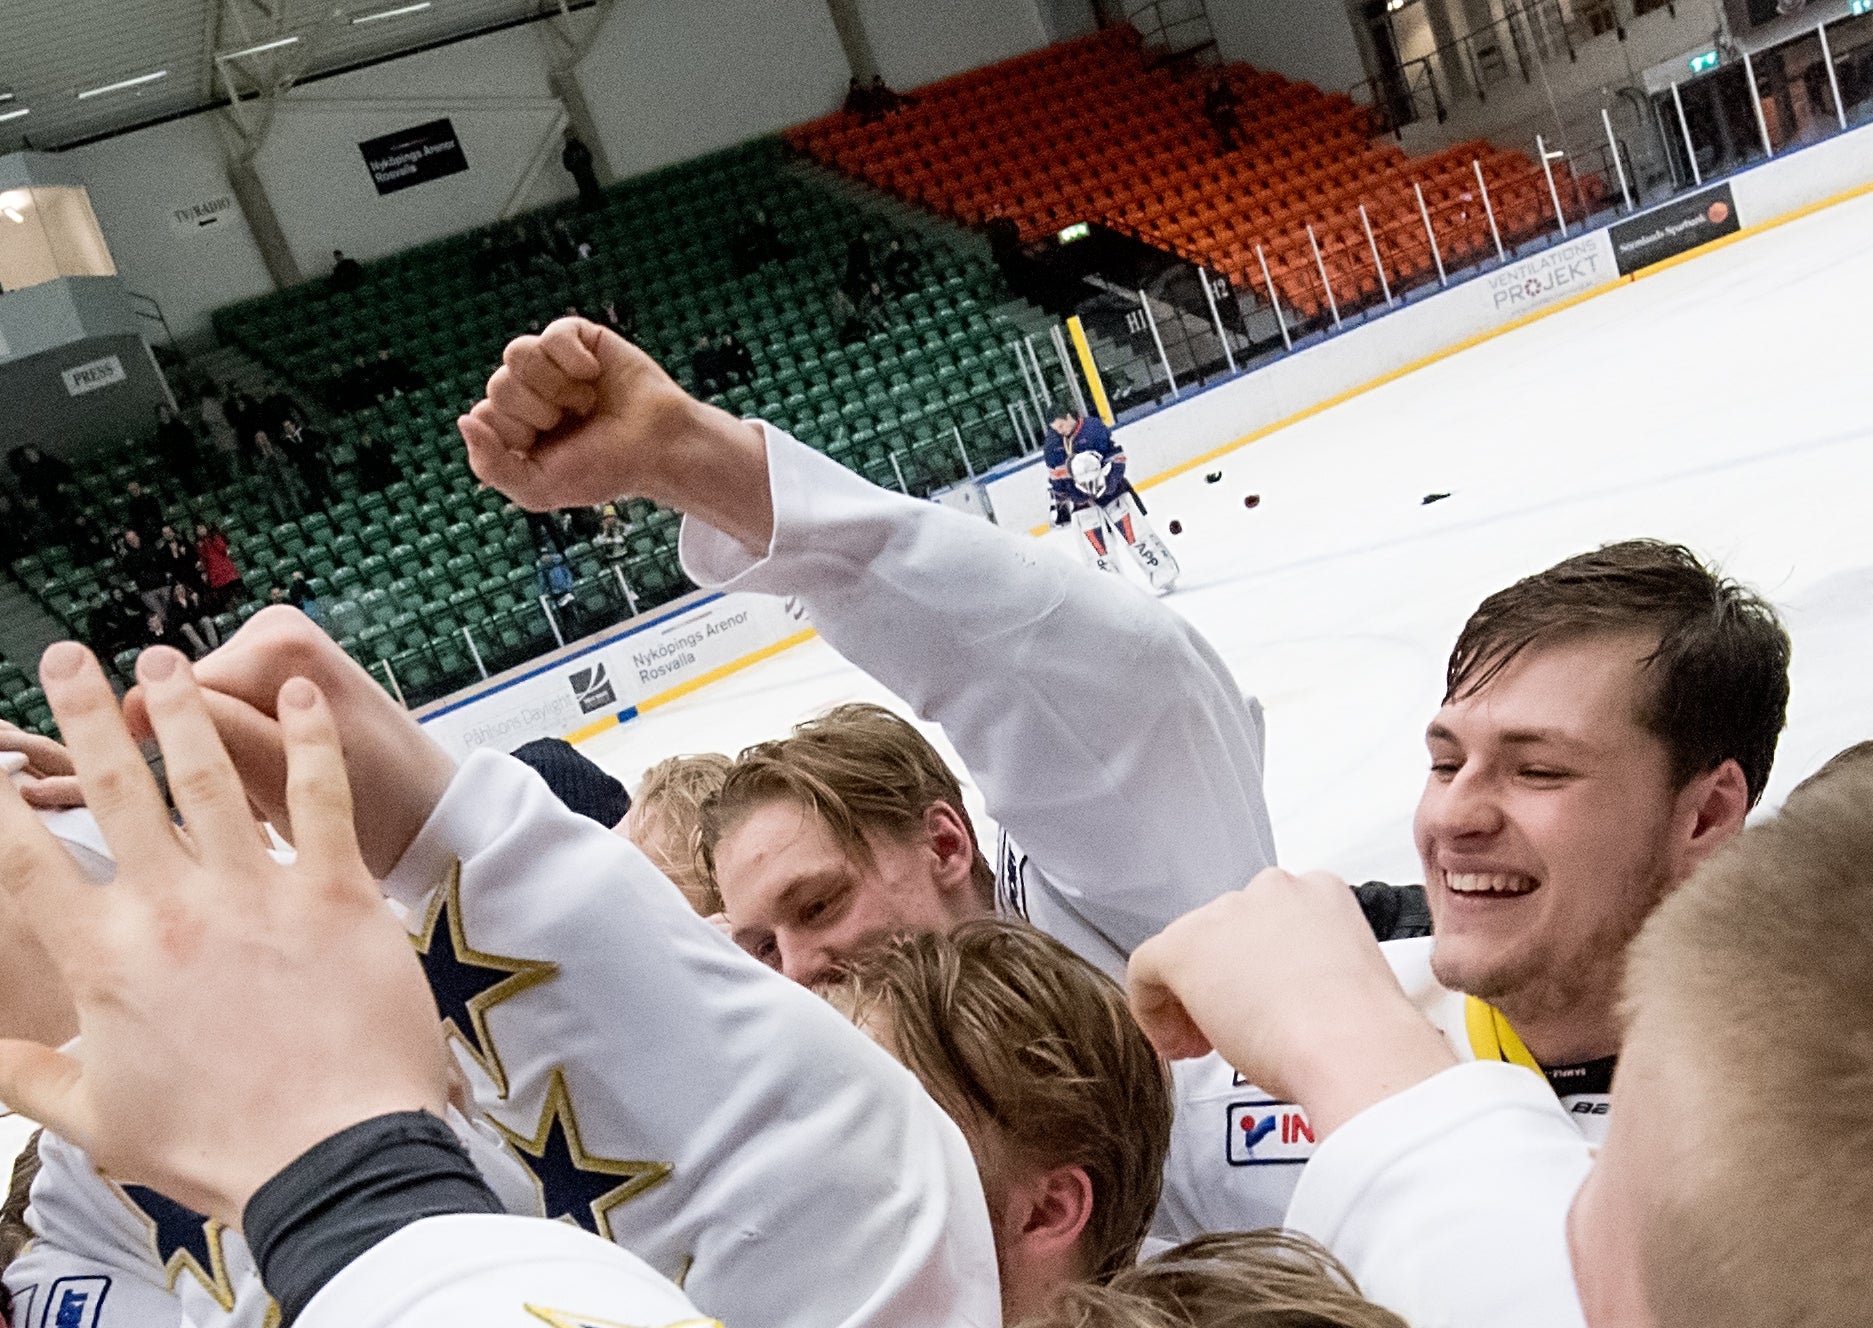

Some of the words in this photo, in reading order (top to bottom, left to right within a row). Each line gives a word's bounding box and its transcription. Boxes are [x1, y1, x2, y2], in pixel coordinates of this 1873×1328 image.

[1488, 239, 1598, 289] VENTILATIONS
[1493, 253, 1599, 310] PROJEKT
[72, 363, 114, 386] PRESS
[632, 630, 704, 668] Nyköpings
[705, 610, 748, 637] Arenor
[639, 652, 696, 684] Rosvalla
